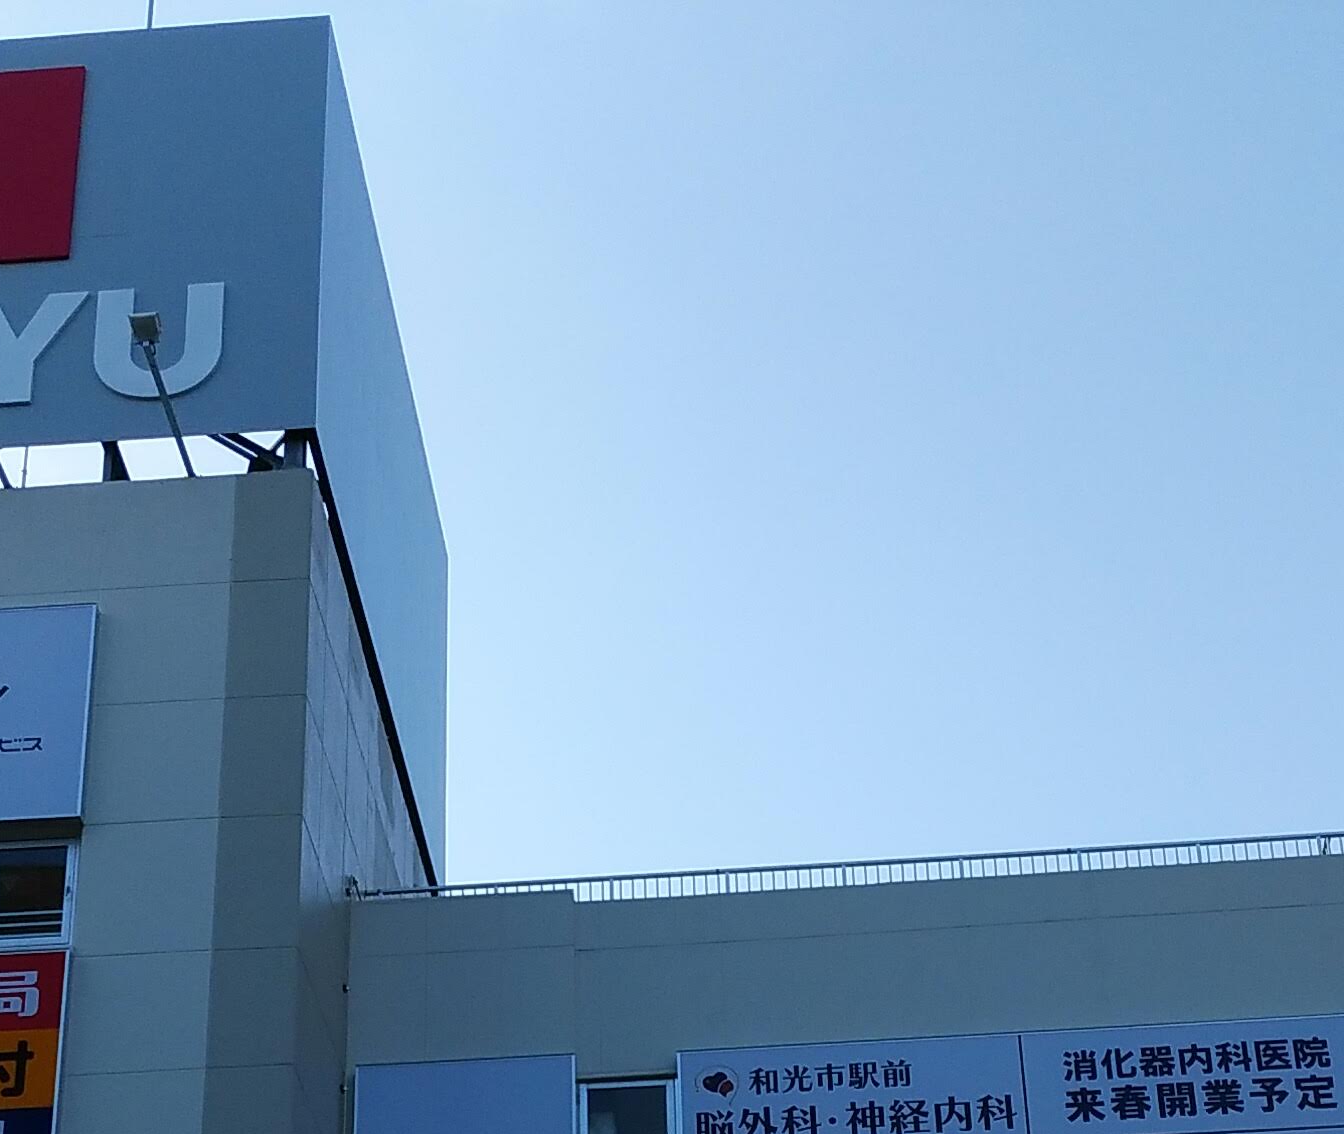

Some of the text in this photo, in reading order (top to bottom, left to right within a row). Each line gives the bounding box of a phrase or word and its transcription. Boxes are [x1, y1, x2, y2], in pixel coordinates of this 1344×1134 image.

[748, 1059, 913, 1096] 和光市駅前
[1061, 1036, 1332, 1083] 消化器内科医院
[1064, 1074, 1339, 1123] 来春開業予定
